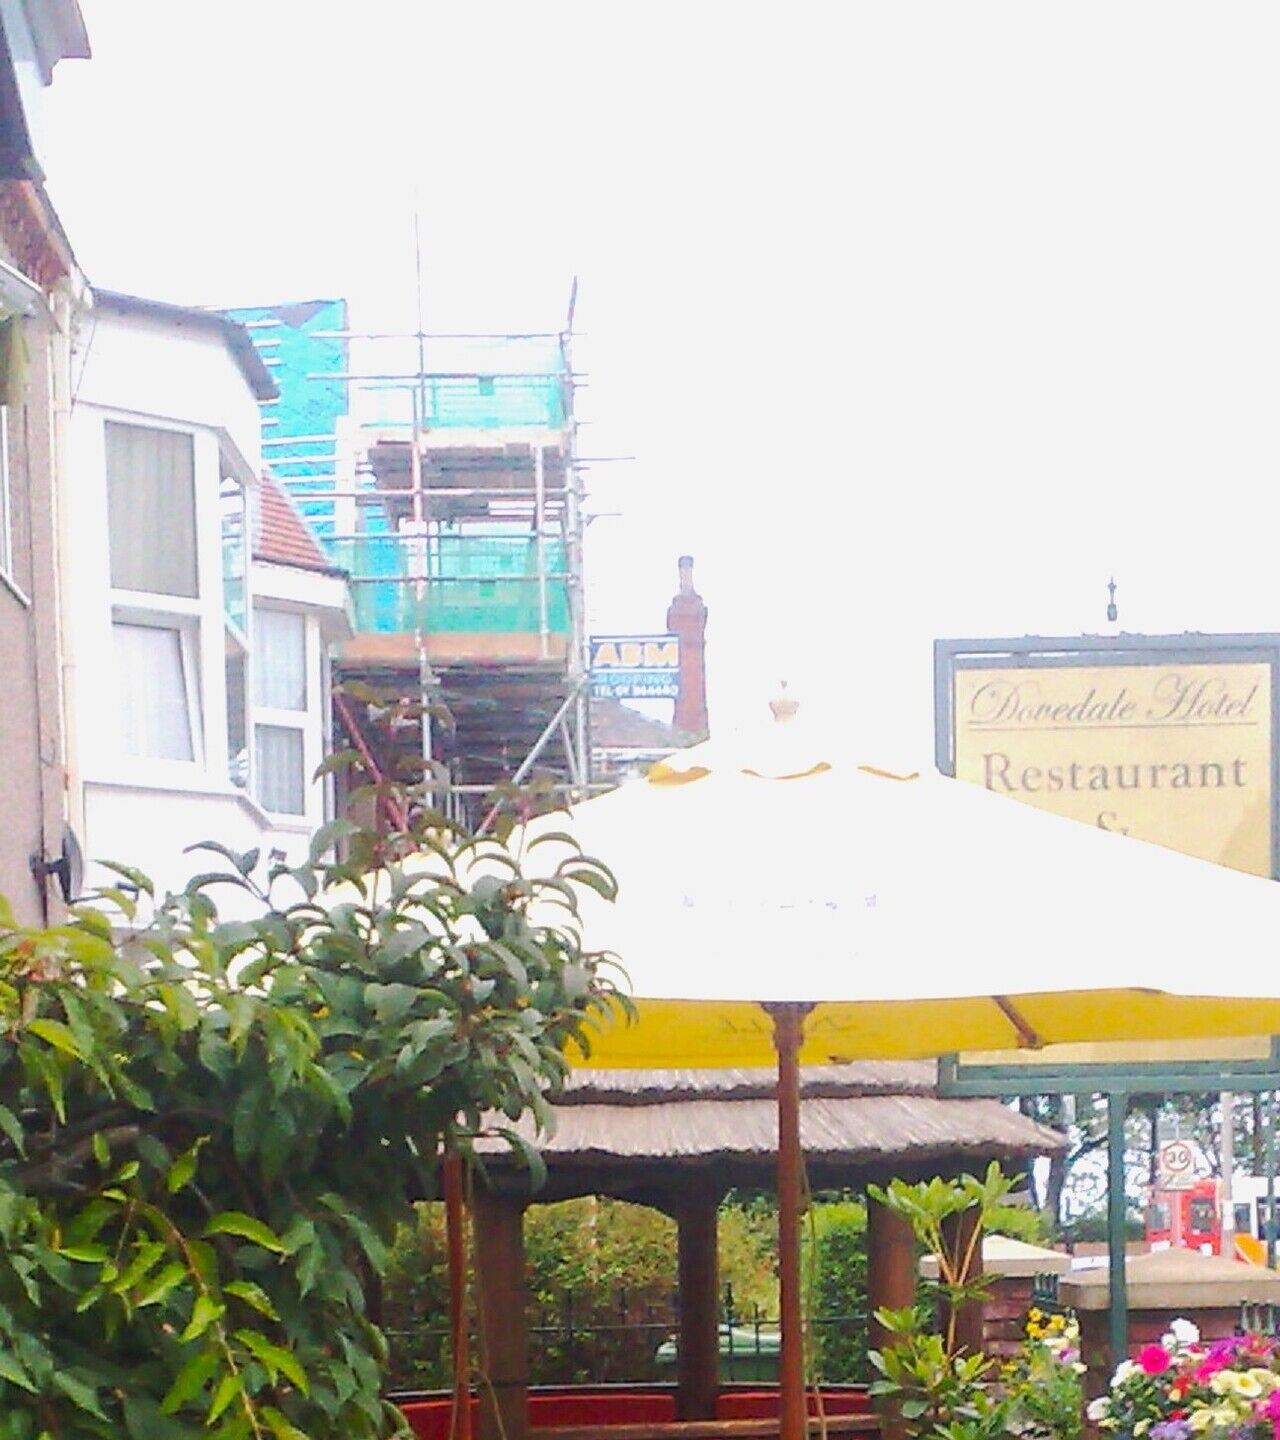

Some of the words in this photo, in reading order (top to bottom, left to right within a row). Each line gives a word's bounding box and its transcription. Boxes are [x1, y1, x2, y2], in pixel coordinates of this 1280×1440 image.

[970, 679, 1138, 722] Dovedale
[1145, 673, 1261, 721] Hotel
[983, 751, 1247, 793] Restaurant
